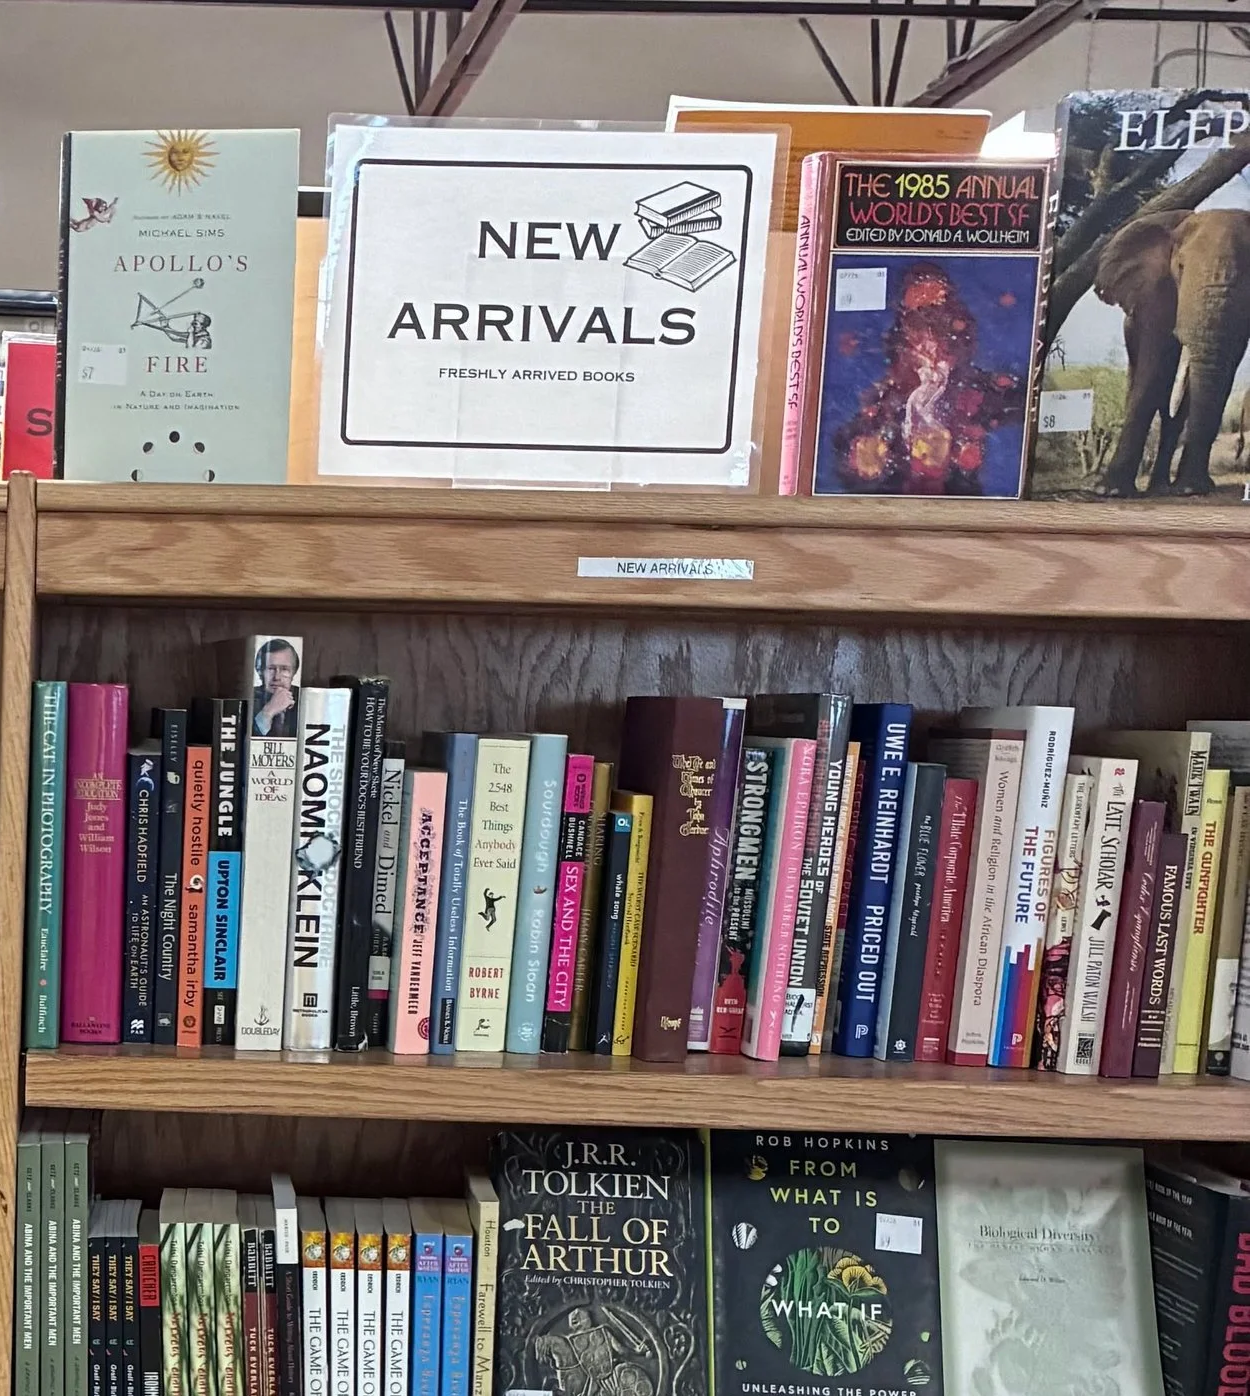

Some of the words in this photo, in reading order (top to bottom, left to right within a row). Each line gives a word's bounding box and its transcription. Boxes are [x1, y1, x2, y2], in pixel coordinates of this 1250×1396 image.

[845, 172, 893, 198] THE
[895, 173, 950, 199] 1985
[956, 175, 1039, 199] ANNUAL
[949, 203, 1005, 227] BEST
[1007, 204, 1029, 227] SF
[478, 222, 622, 261] NEW
[846, 228, 886, 242] EDITED
[888, 229, 902, 242] BY
[905, 229, 951, 243] DONALD
[953, 230, 964, 243] A.
[966, 230, 1029, 244] WOLLHEIM
[114, 255, 248, 272] APOLLO'S
[387, 302, 697, 346] ARRIVALS
[146, 356, 208, 373] FIRE
[439, 366, 508, 381] FRESHLY
[512, 368, 578, 383] ARRIVED
[583, 370, 636, 383] BOOKS
[617, 562, 648, 575] NEW
[651, 562, 714, 577] ARRIVALS
[220, 715, 237, 752] THE
[262, 742, 284, 754] BILL
[884, 723, 906, 760] UWE
[252, 755, 295, 768] MOYERS
[881, 767, 901, 785] E.
[192, 760, 206, 812] quietly
[217, 760, 236, 838] JUNGLE
[190, 811, 202, 867] hostile
[870, 787, 899, 884] REINHARDT
[215, 859, 230, 909] UPTON
[563, 866, 579, 893] SEX
[1193, 850, 1215, 936] GUNFIGHTER
[293, 868, 324, 970] KLEIN
[560, 897, 575, 932] AND
[186, 903, 198, 975] samantha
[213, 914, 228, 982] SINCLAIR
[862, 905, 885, 965] PRICED
[557, 935, 573, 968] THE
[183, 980, 198, 1008] irby
[552, 970, 569, 1008] CITY
[856, 971, 877, 1003] OUT
[561, 1140, 638, 1168] J.R.R.
[755, 1134, 797, 1148] ROB
[803, 1137, 891, 1152] HOPKINS
[788, 1159, 858, 1179] FROM
[521, 1169, 671, 1201] TOLKIEN
[769, 1187, 845, 1207] WHAT
[856, 1188, 878, 1208] IS
[577, 1199, 616, 1216] THE
[522, 1215, 611, 1246] FALL
[622, 1218, 670, 1246] OF
[808, 1216, 841, 1235] TO
[520, 1245, 674, 1279] ARTHUR
[310, 1308, 322, 1334] THE
[771, 1299, 850, 1319] WHAT
[859, 1300, 884, 1321] IF
[310, 1338, 323, 1373] GAME
